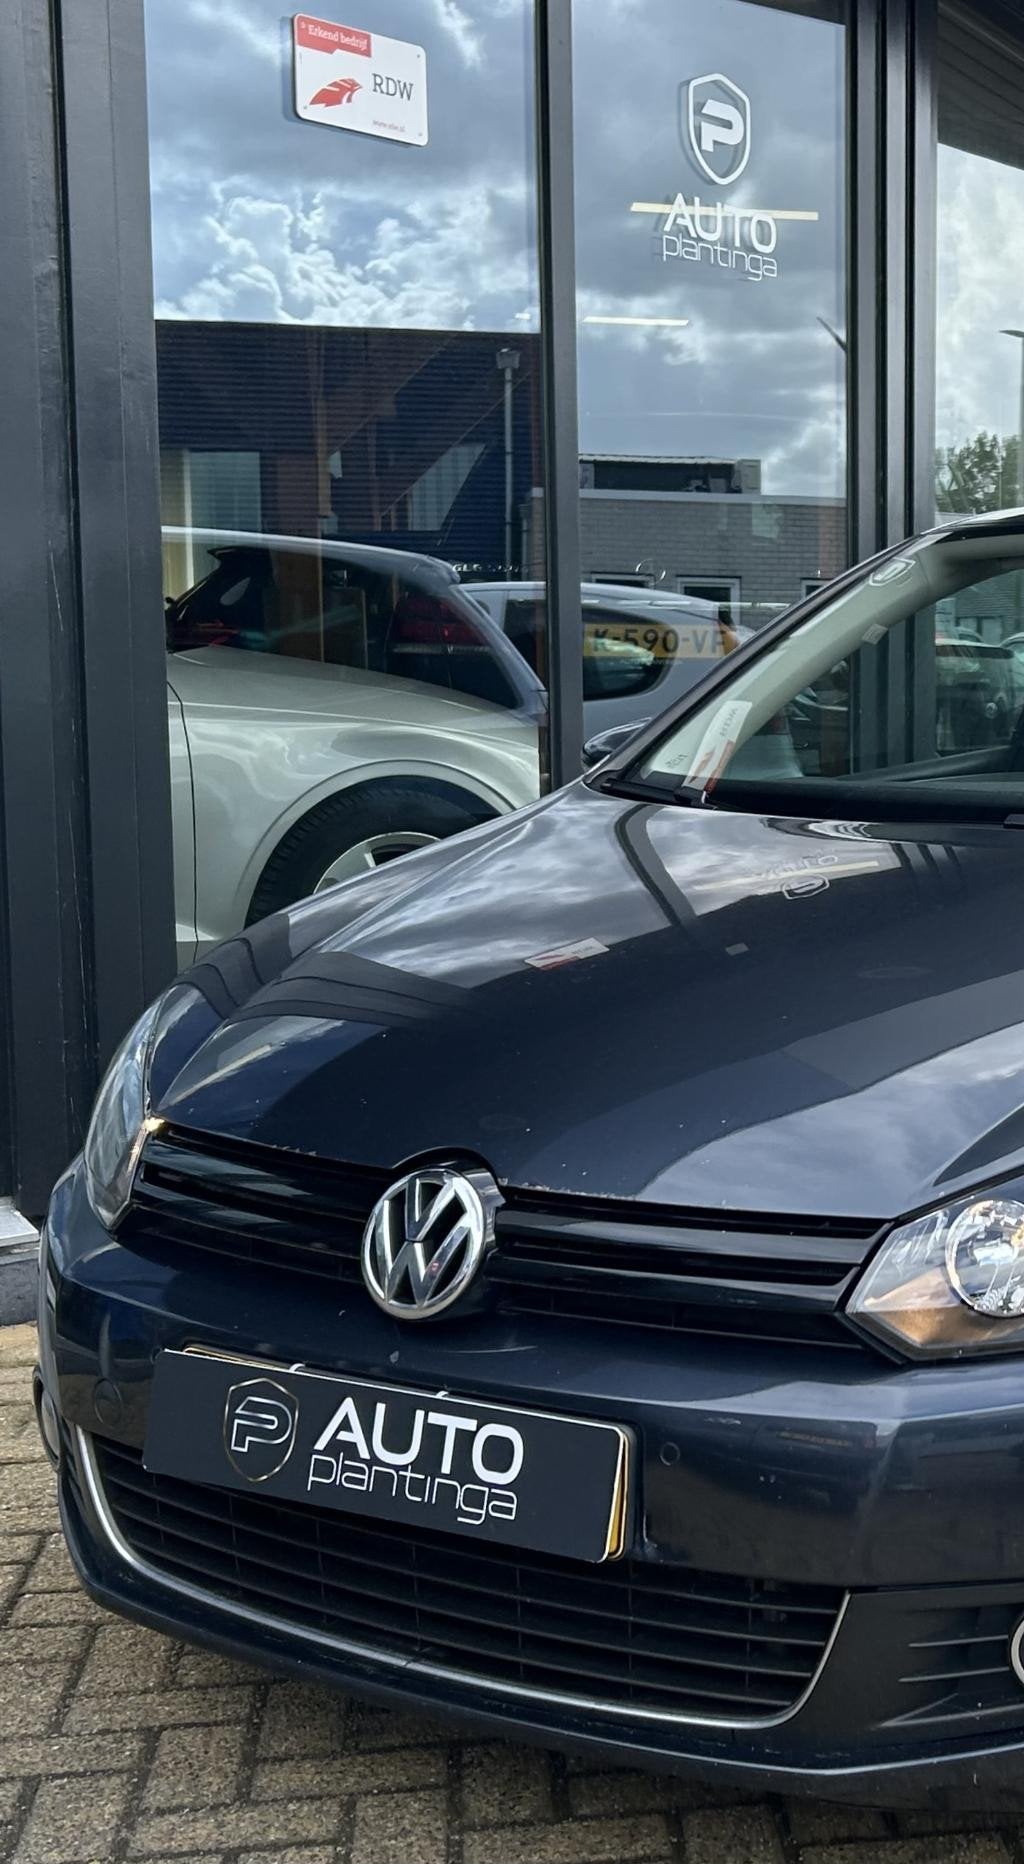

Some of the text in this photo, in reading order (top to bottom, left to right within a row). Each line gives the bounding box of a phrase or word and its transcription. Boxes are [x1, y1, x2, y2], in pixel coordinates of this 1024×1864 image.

[308, 24, 369, 51] Erkend bedrijf
[372, 73, 414, 101] RDW
[664, 192, 777, 254] AUTO
[663, 232, 778, 282] plantinga
[313, 1397, 524, 1486] AUTO
[307, 1451, 518, 1526] plantinga
